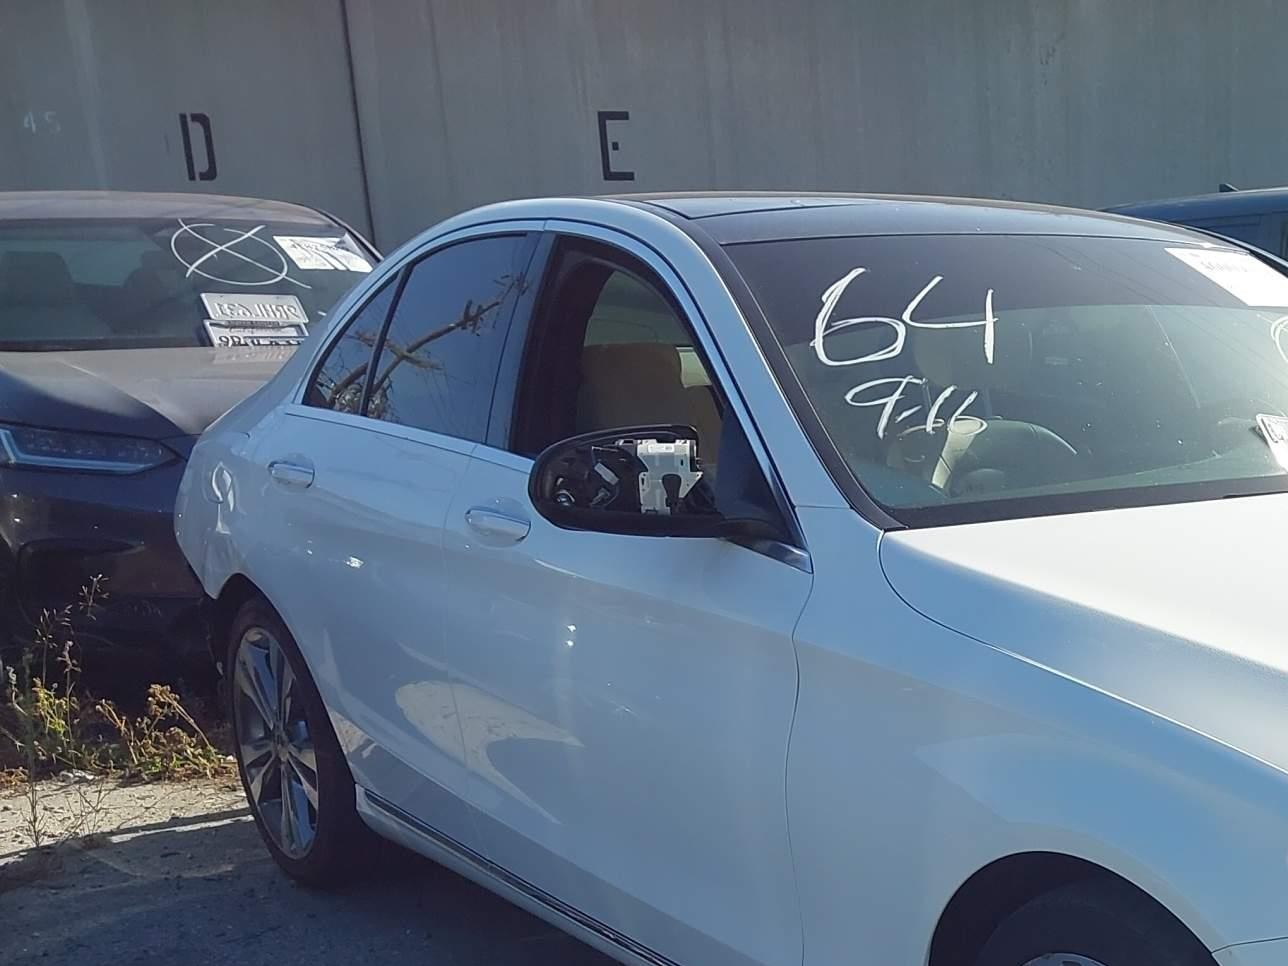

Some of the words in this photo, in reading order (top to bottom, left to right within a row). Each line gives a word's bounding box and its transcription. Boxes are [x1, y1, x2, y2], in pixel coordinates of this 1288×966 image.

[179, 112, 217, 181] D
[597, 110, 635, 181] E
[810, 267, 999, 367] 64
